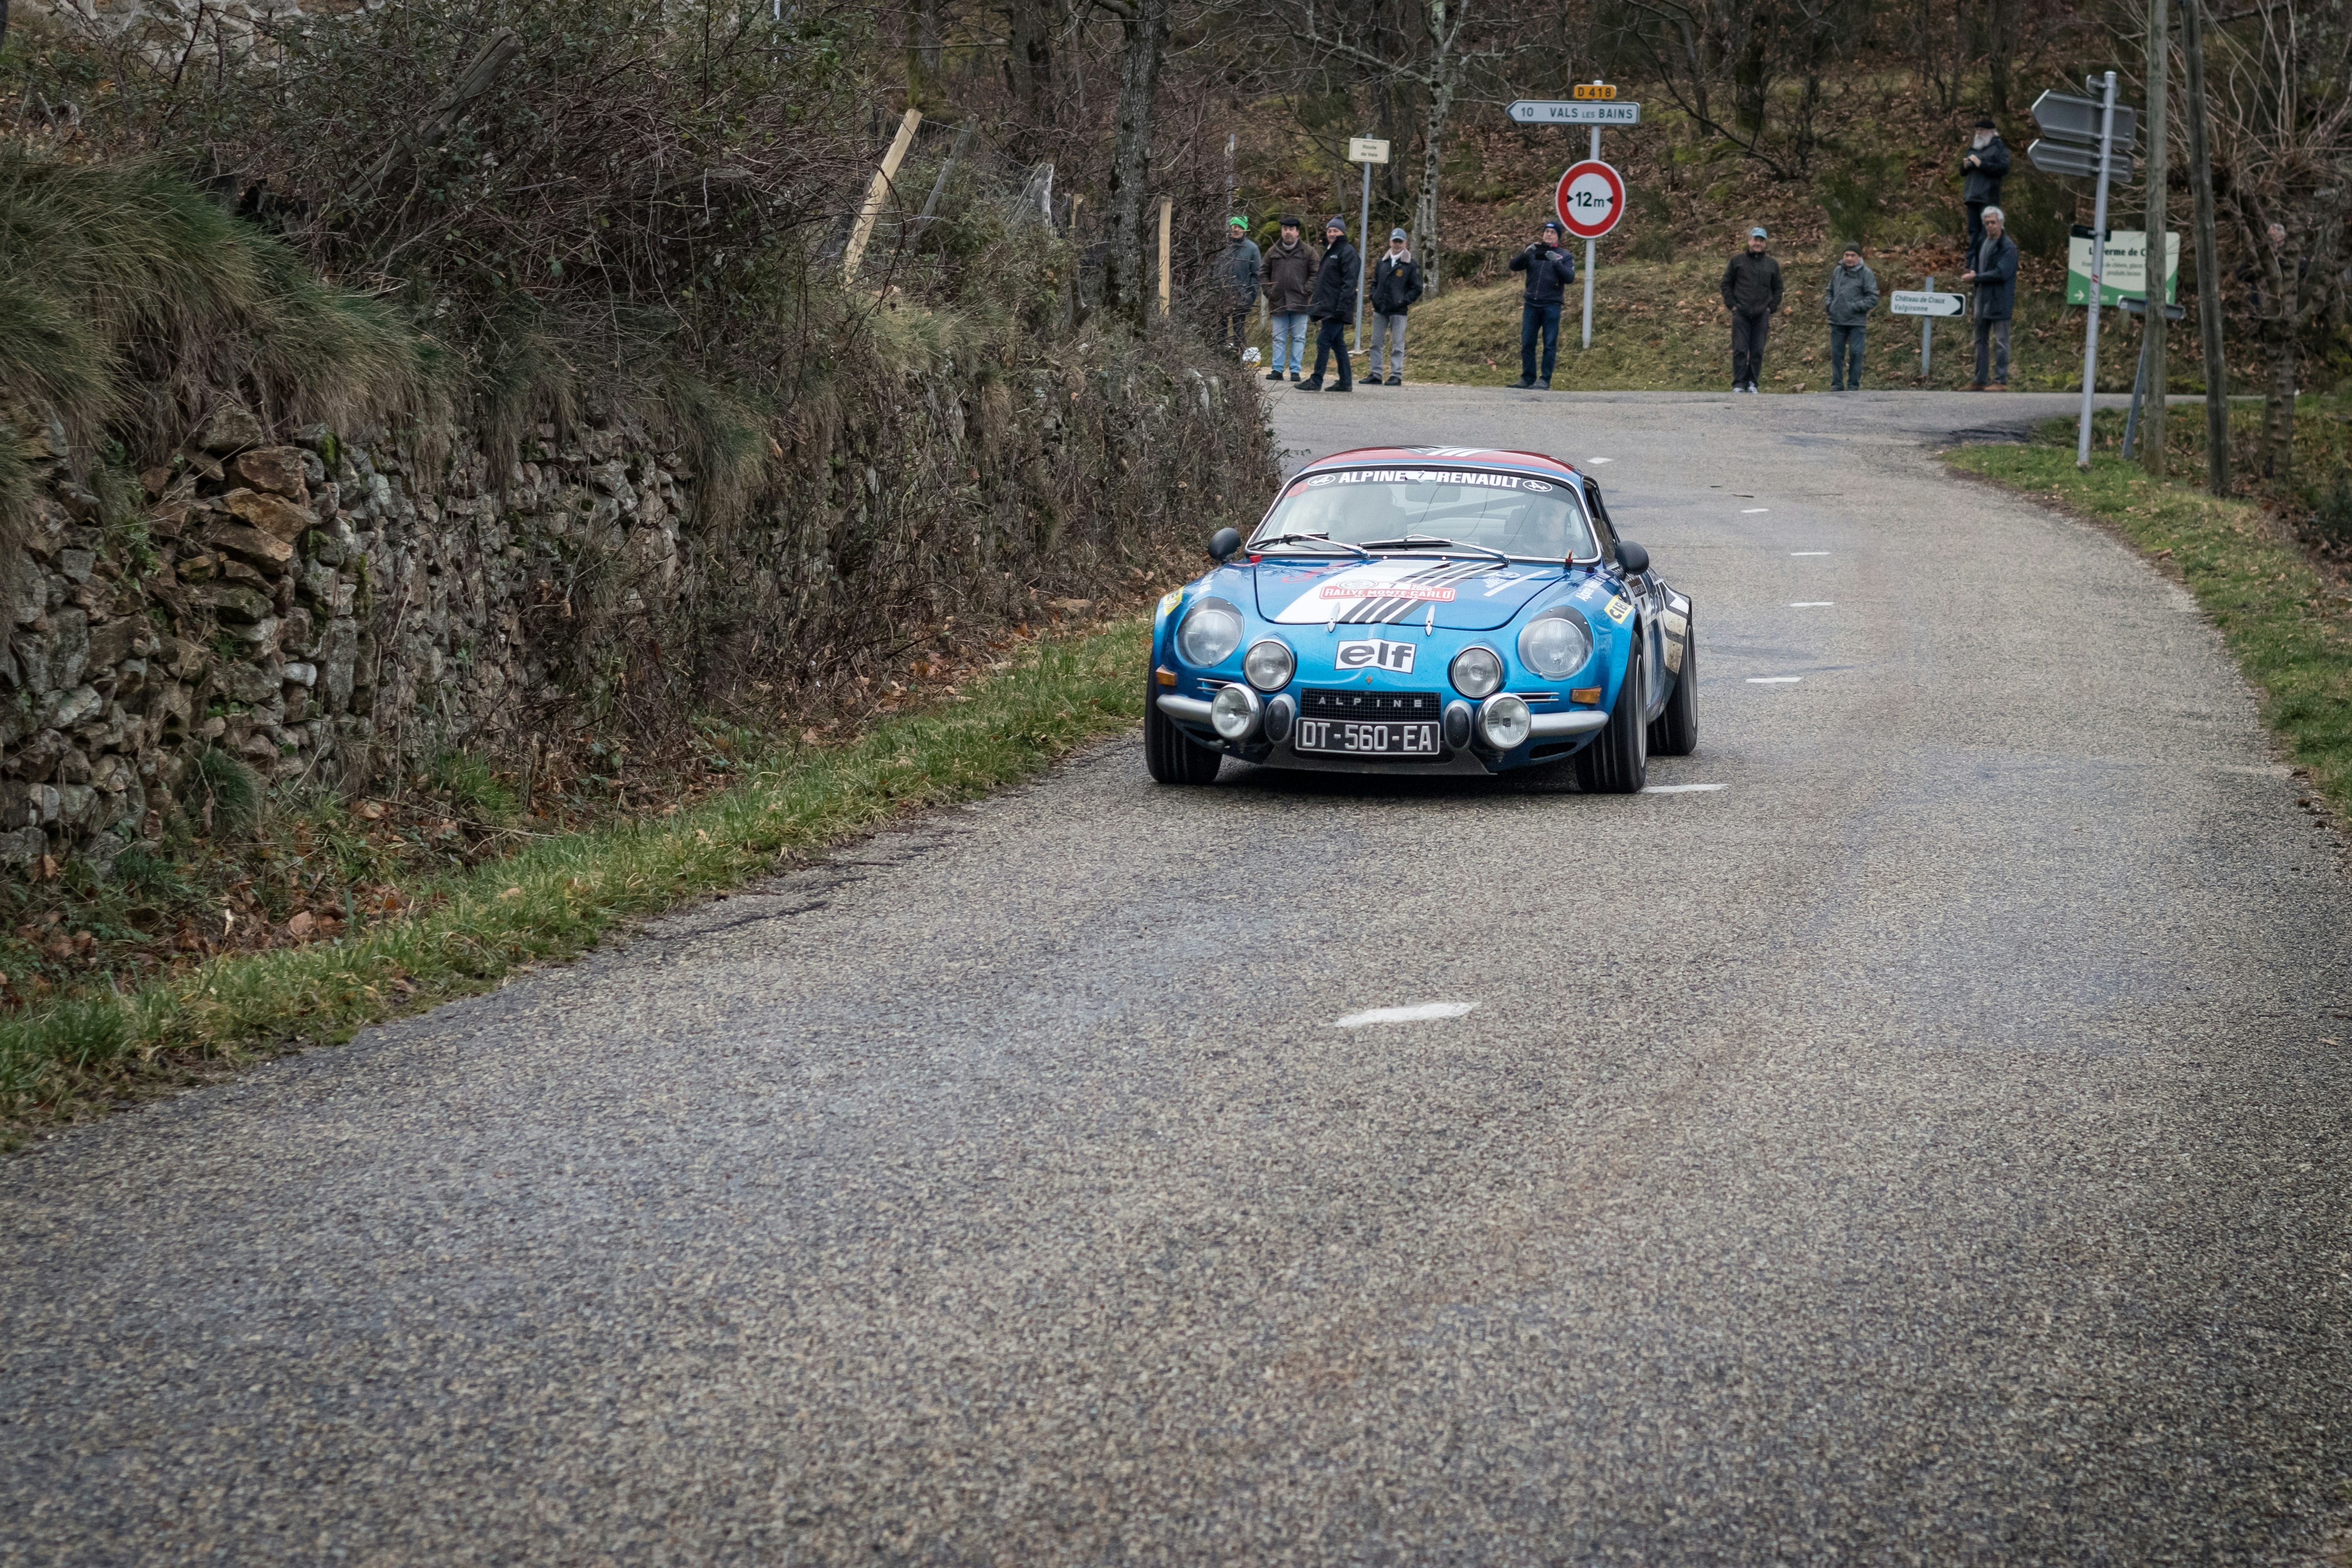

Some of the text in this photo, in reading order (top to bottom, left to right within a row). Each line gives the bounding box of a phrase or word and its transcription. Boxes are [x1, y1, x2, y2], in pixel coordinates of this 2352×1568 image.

[1578, 87, 1612, 97] D 418
[1521, 107, 1534, 117] 10
[1549, 107, 1578, 118] VALS
[1599, 108, 1633, 119] BAINS
[1575, 191, 1605, 208] 12m
[2104, 247, 2126, 256] erme
[2128, 247, 2138, 257] de
[1338, 471, 1521, 488] ALPINE RENAULT
[1324, 588, 1451, 599] RALLYE MONTE-CARLO
[1340, 642, 1413, 668] elf
[1318, 696, 1422, 708] ALPINE
[1302, 721, 1432, 751] DT-560-EA
